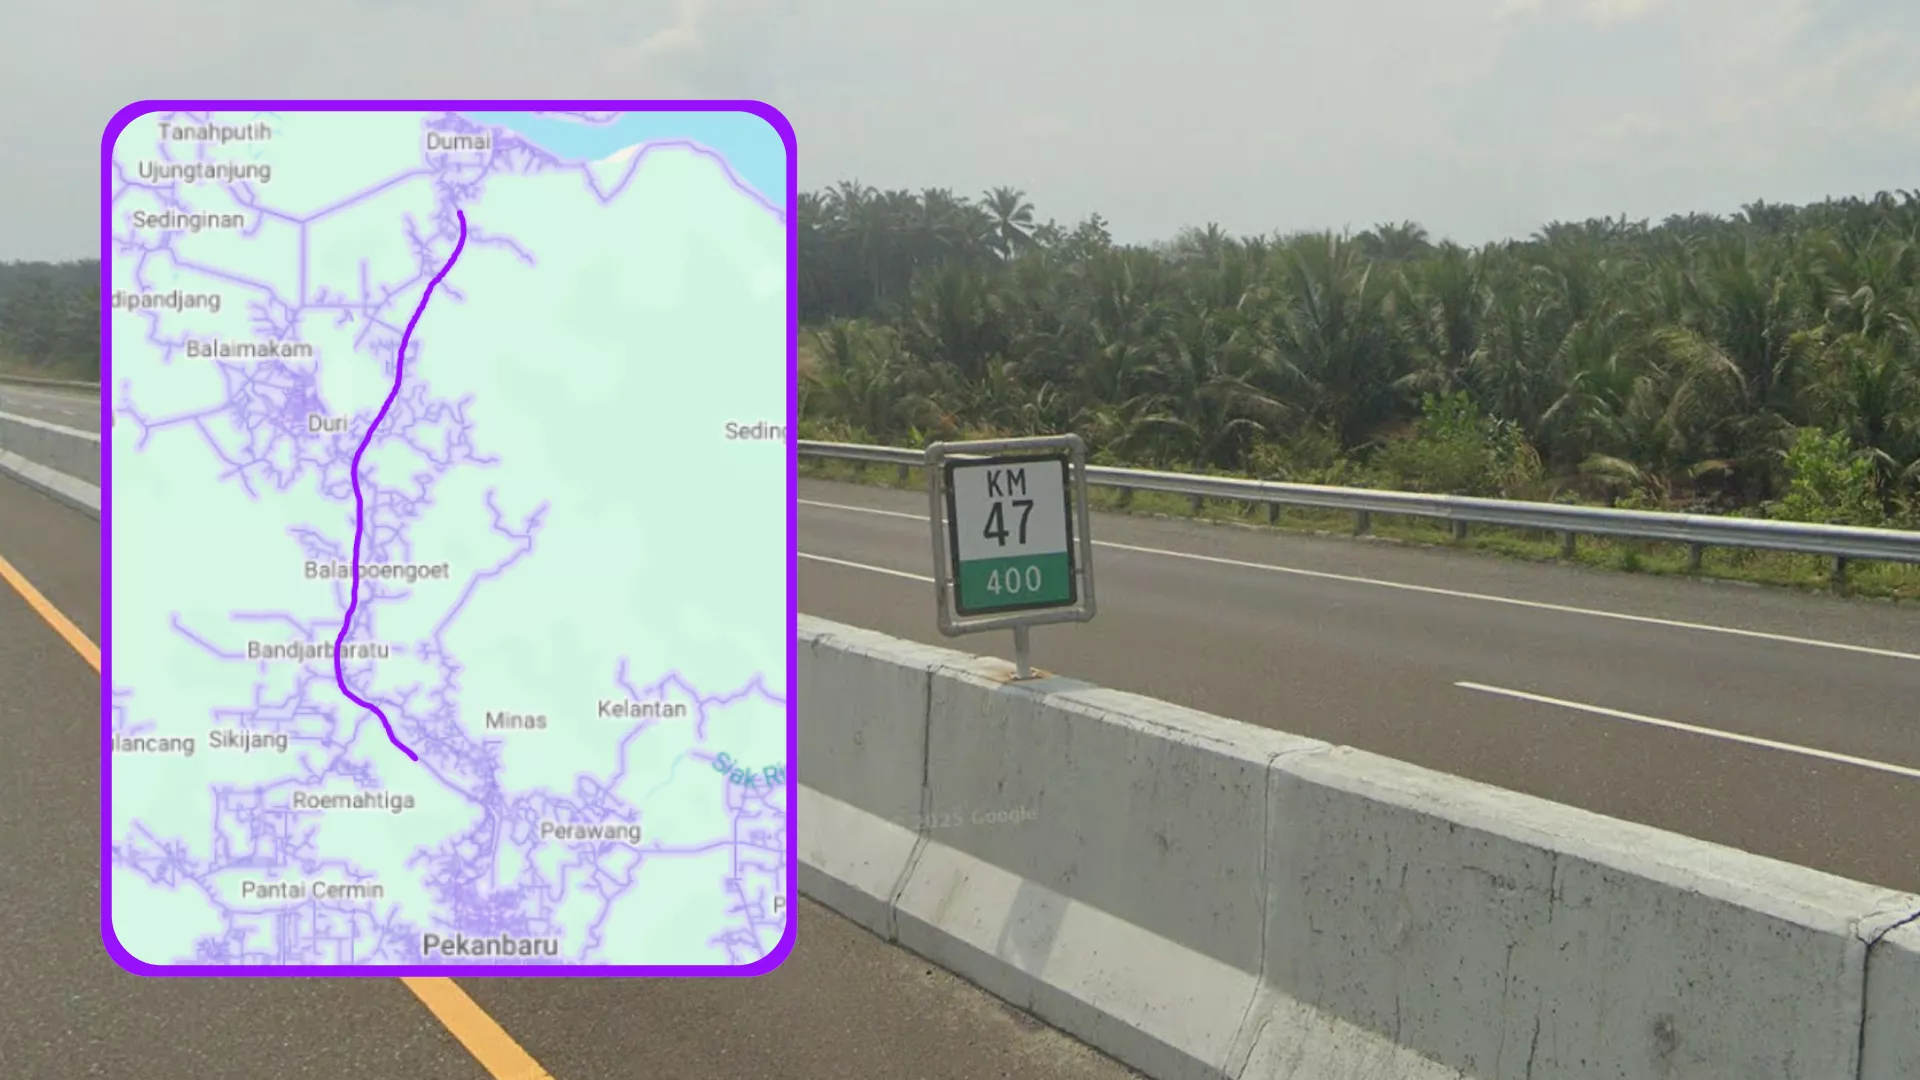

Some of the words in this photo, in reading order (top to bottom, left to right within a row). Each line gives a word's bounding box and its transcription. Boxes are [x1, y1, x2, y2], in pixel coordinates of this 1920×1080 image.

[987, 468, 1027, 497] KM
[983, 499, 1035, 547] 47
[986, 565, 1042, 595] 400
